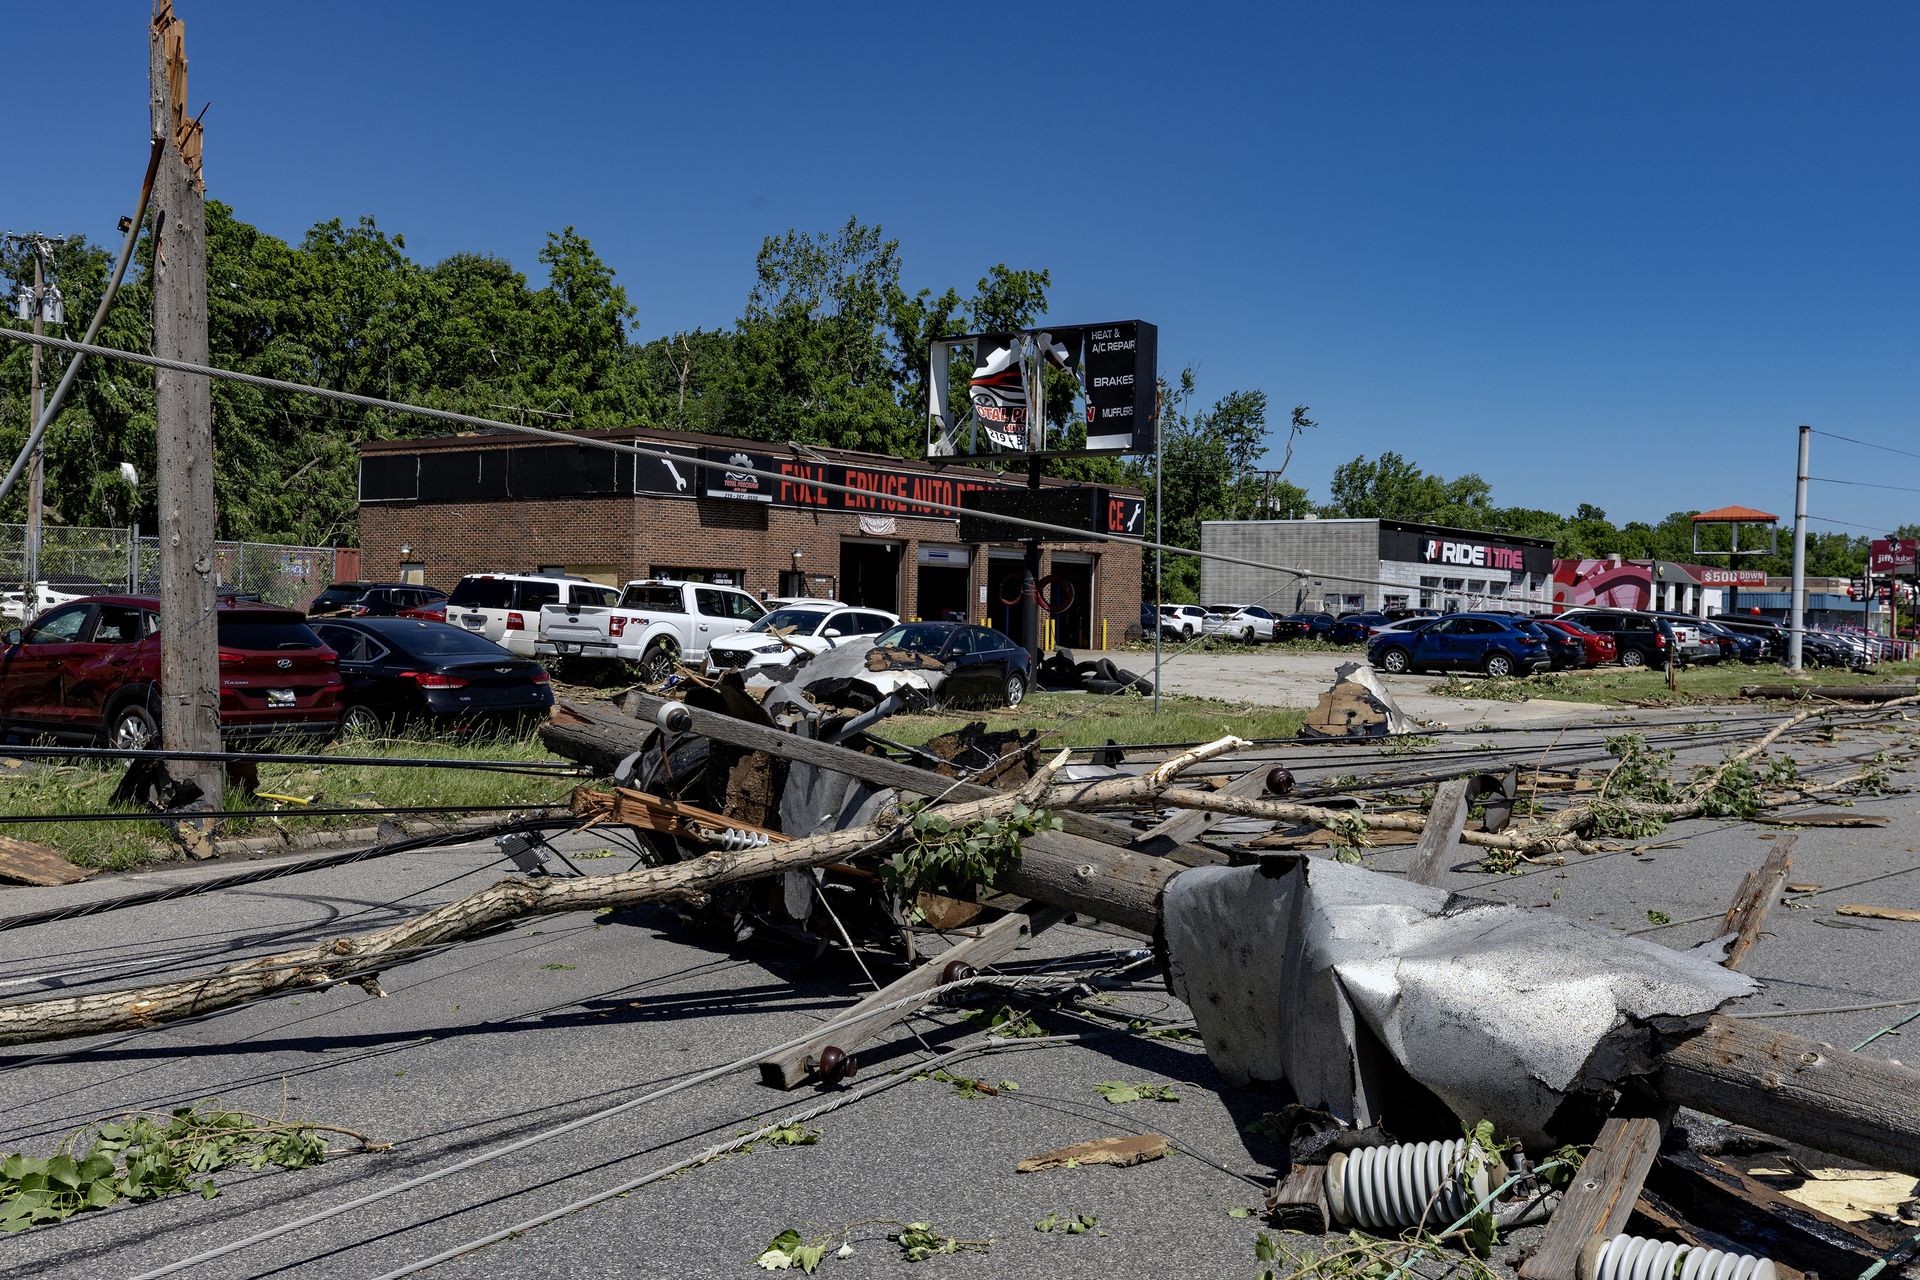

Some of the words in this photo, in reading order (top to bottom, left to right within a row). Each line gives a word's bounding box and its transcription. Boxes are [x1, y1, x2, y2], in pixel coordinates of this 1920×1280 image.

[1091, 330, 1112, 340] HEAT
[1114, 328, 1120, 338] &
[1092, 342, 1106, 354] A/C
[1107, 340, 1135, 351] REPAIR
[1094, 375, 1134, 387] BRAKES
[976, 406, 1009, 422] OTAL
[1102, 406, 1133, 418] MUFFLERS
[781, 463, 828, 505] FULL
[844, 470, 907, 512] ERVICE
[911, 478, 952, 516] AUTO
[1705, 571, 1737, 583] $500
[1740, 572, 1763, 580] DOWN
